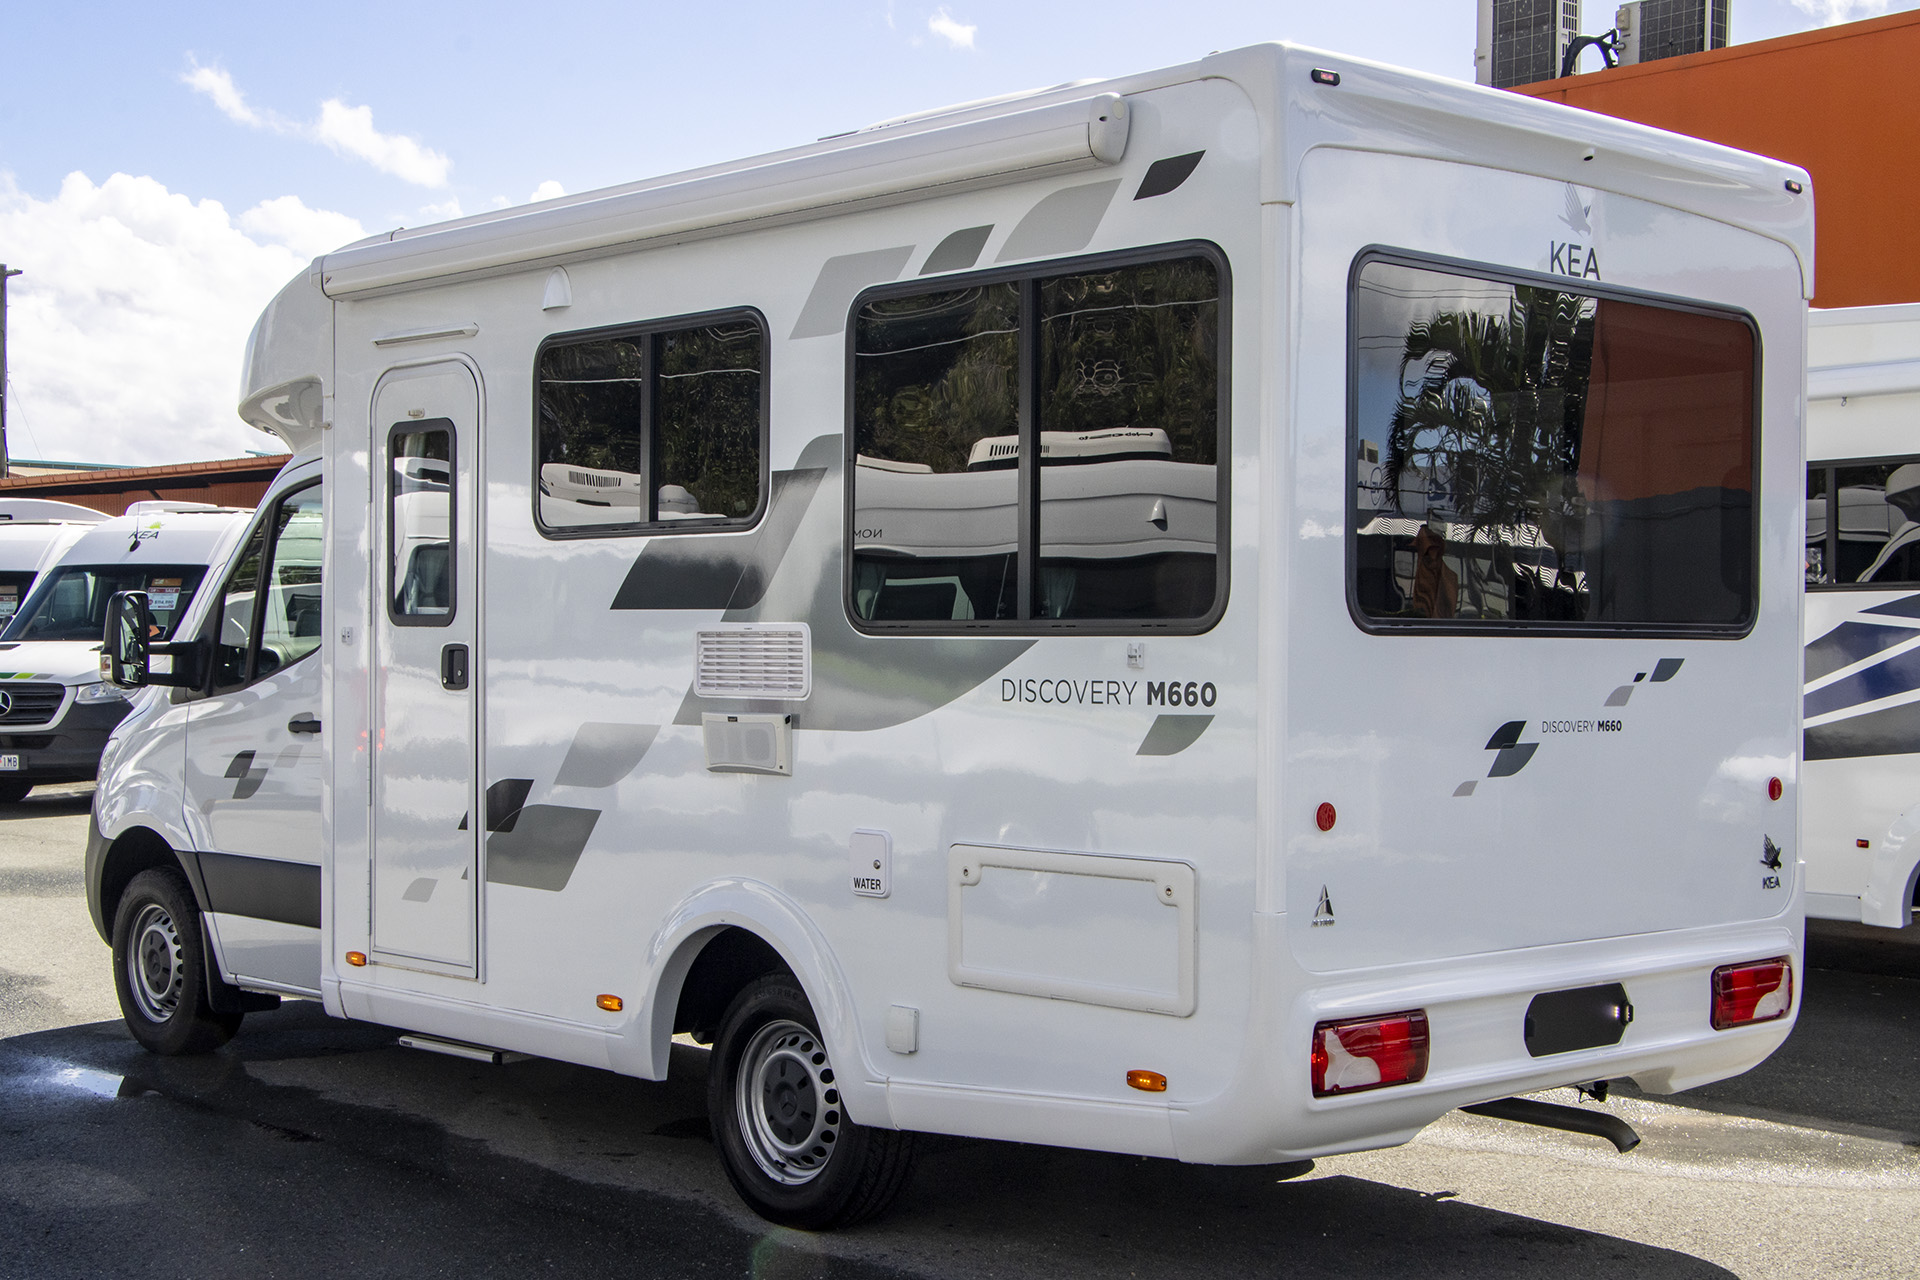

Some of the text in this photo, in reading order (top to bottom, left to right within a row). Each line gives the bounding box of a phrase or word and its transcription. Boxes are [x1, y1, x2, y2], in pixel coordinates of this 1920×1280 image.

[1550, 240, 1601, 281] KEA
[128, 530, 160, 540] KEA
[1001, 678, 1218, 708] DISCOVERY M660
[1541, 719, 1623, 734] DISCOVERY M660
[853, 877, 882, 890] WATER
[1762, 876, 1781, 889] KEA
